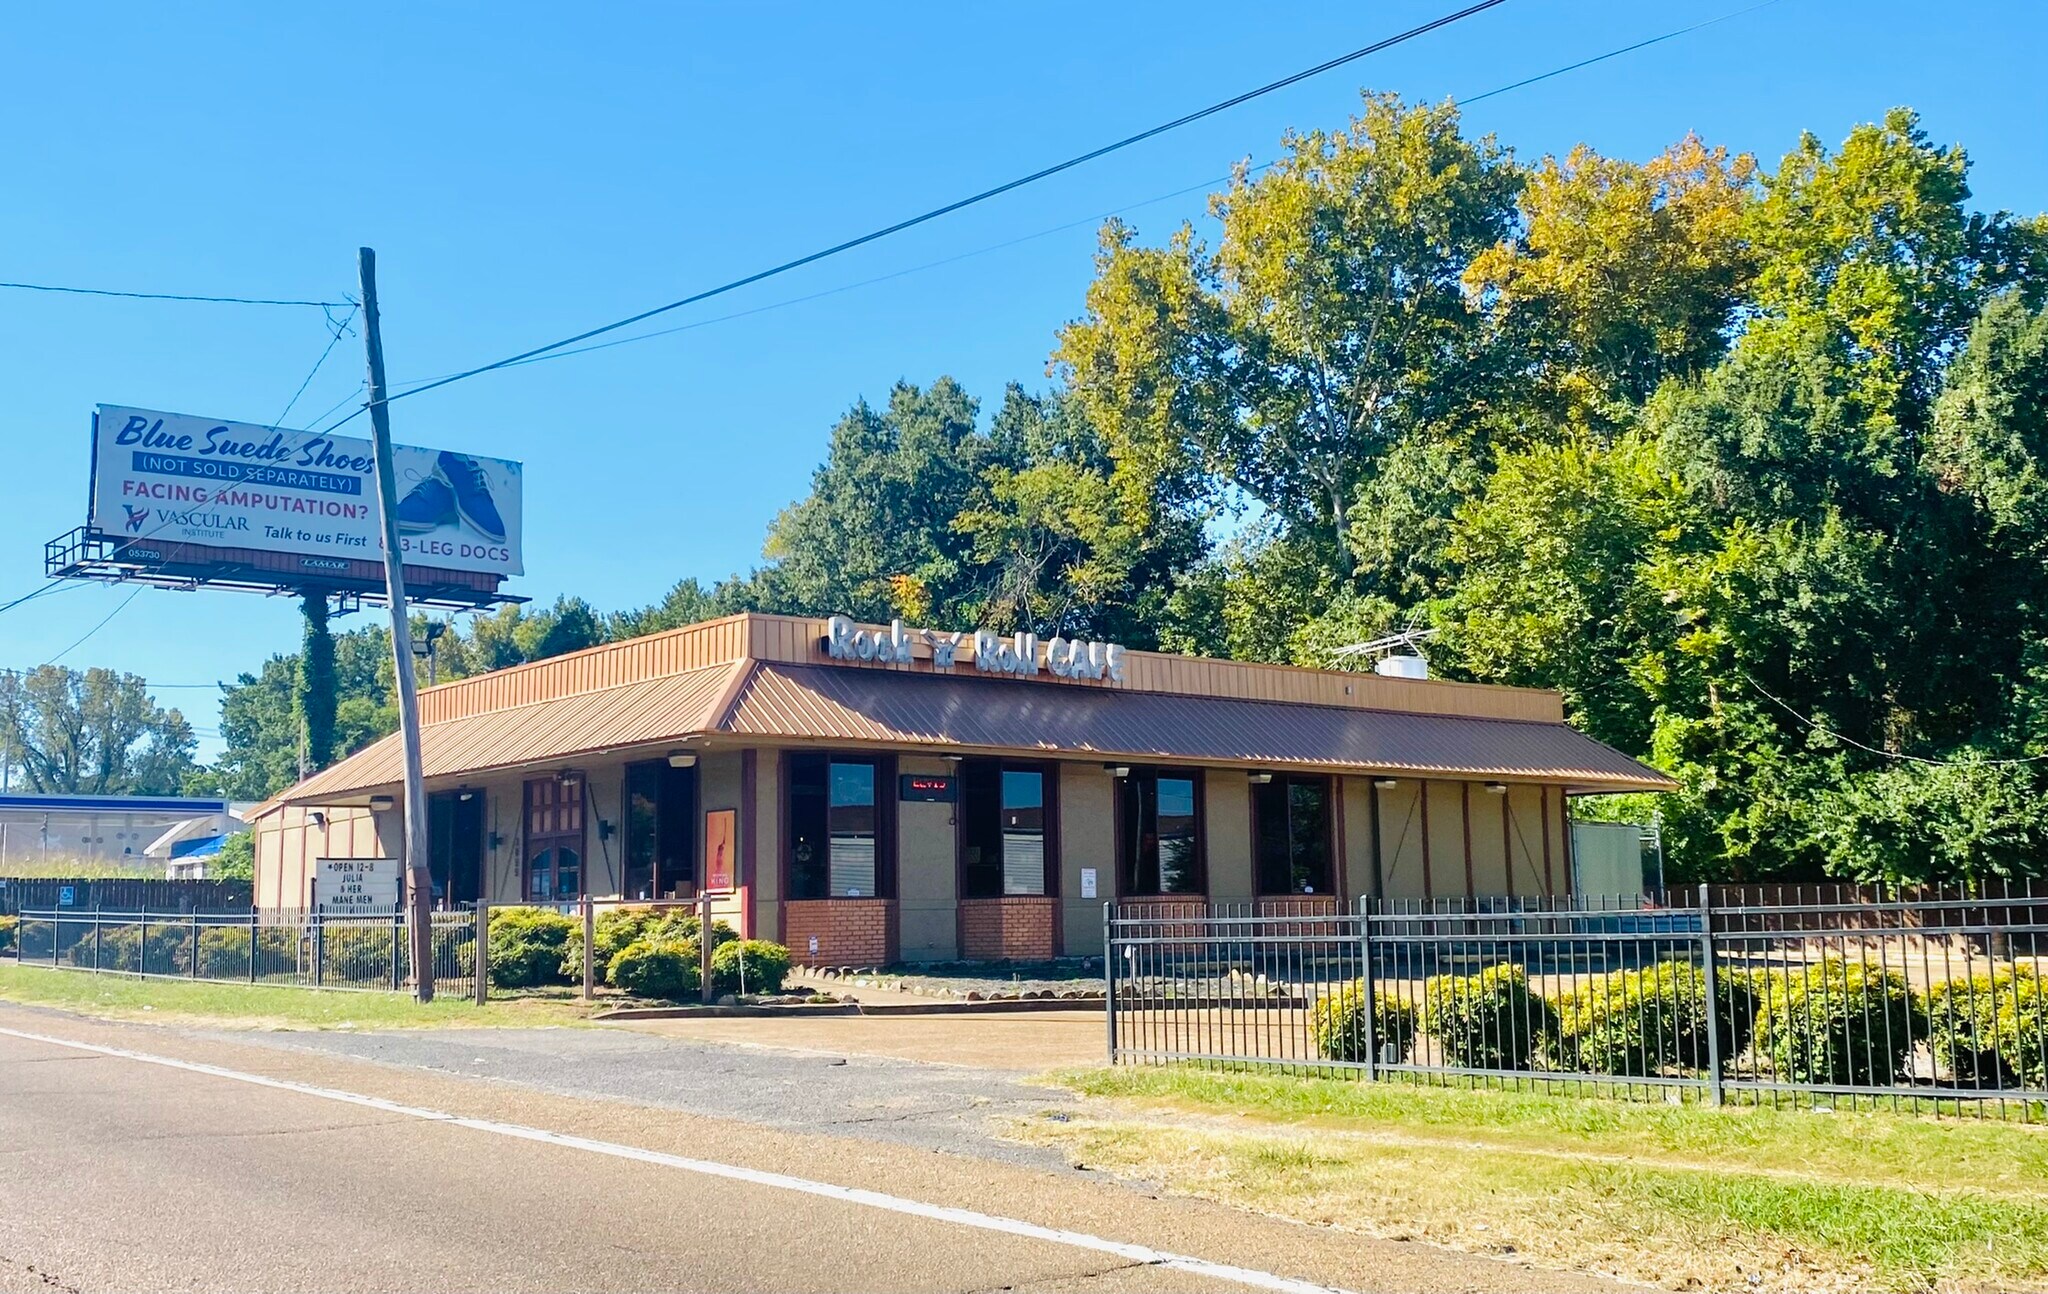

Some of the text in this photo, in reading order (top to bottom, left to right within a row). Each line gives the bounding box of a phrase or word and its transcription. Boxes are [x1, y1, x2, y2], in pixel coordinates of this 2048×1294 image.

[115, 415, 375, 474] Blue Suede Shoes
[143, 455, 352, 492] (NOT SOLD SEPARATELY)
[123, 480, 368, 519] FACING AMPUTATION?
[156, 508, 250, 531] VASCULAR
[182, 528, 225, 539] INSTITUTE
[264, 525, 367, 547] Talk to us First
[128, 549, 160, 559] 053730
[460, 544, 509, 562] DOCS
[303, 559, 346, 569] LAMAR
[333, 863, 354, 872] OPEN
[342, 874, 363, 883] JULIA
[347, 885, 362, 893] HER
[356, 896, 373, 904] MEN
